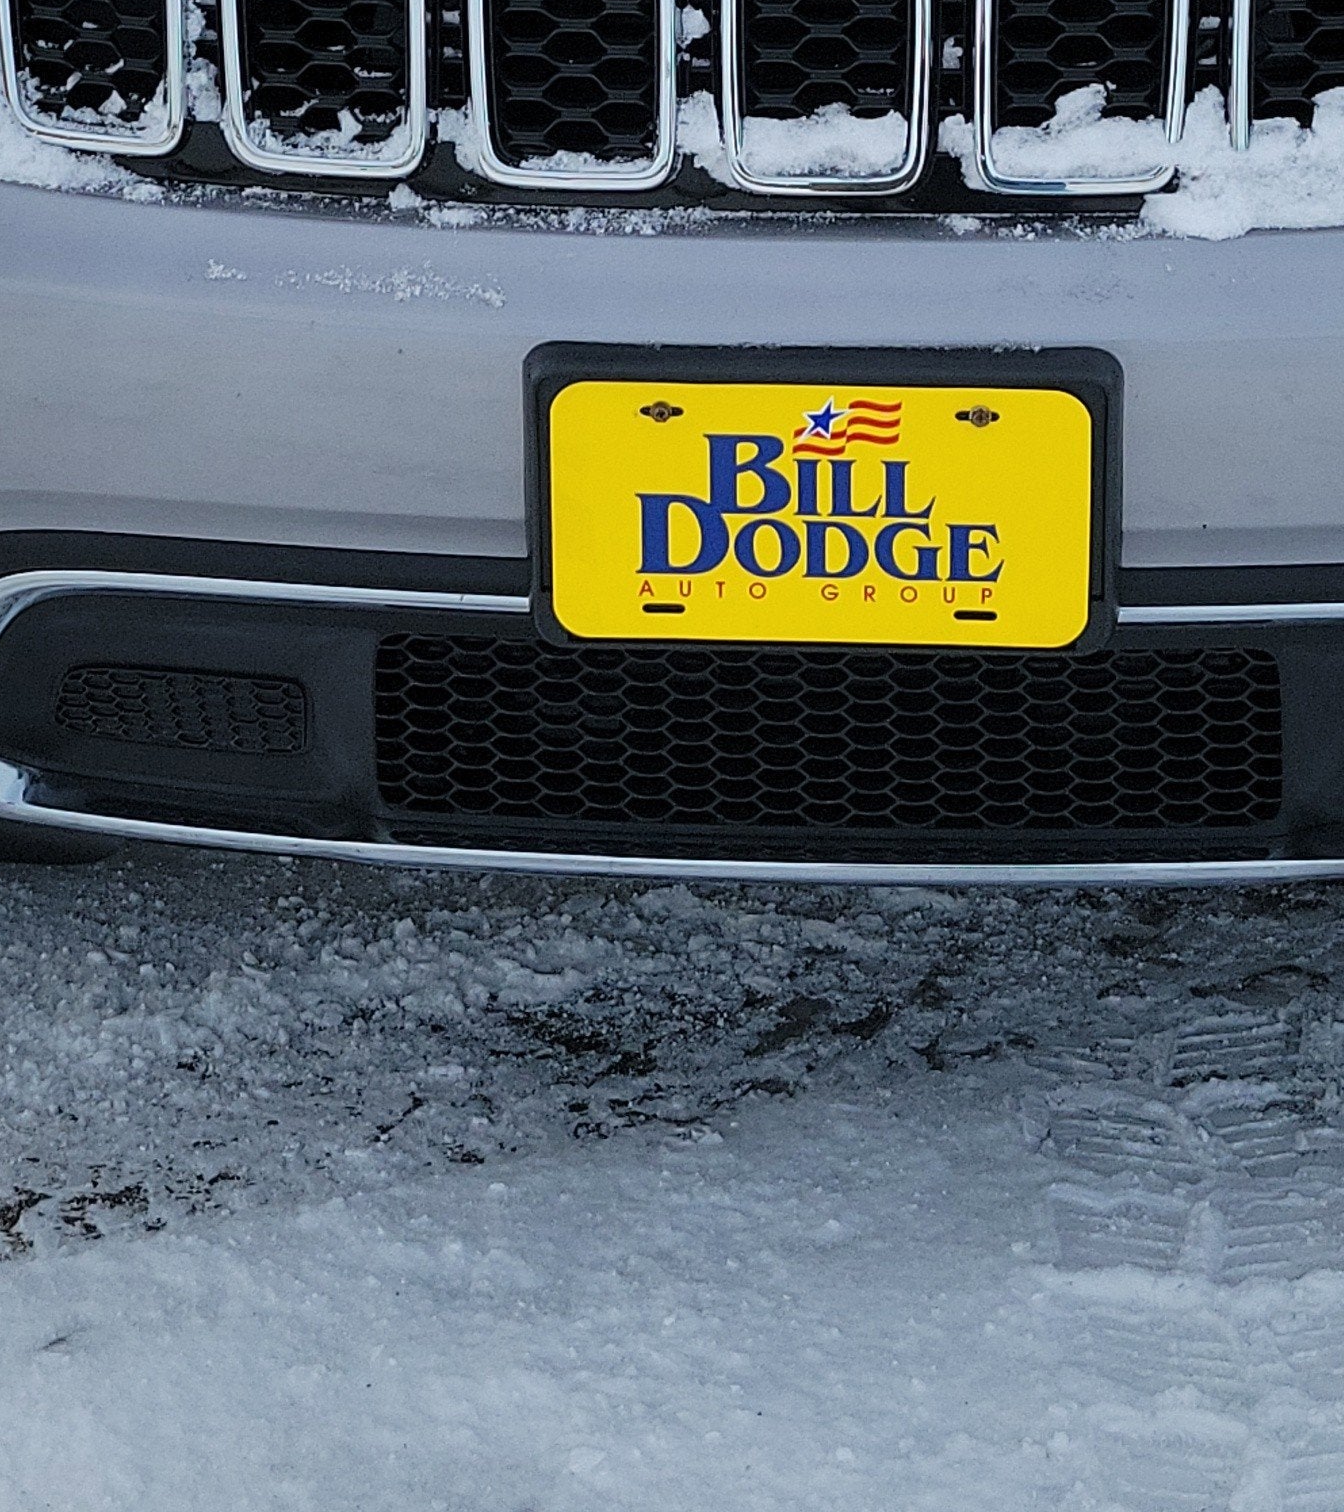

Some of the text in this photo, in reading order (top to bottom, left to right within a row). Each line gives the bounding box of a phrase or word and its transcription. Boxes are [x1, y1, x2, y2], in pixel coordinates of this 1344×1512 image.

[703, 433, 936, 520] BILL
[634, 492, 1005, 583] DODGE
[638, 579, 994, 605] AUTO GROUP
